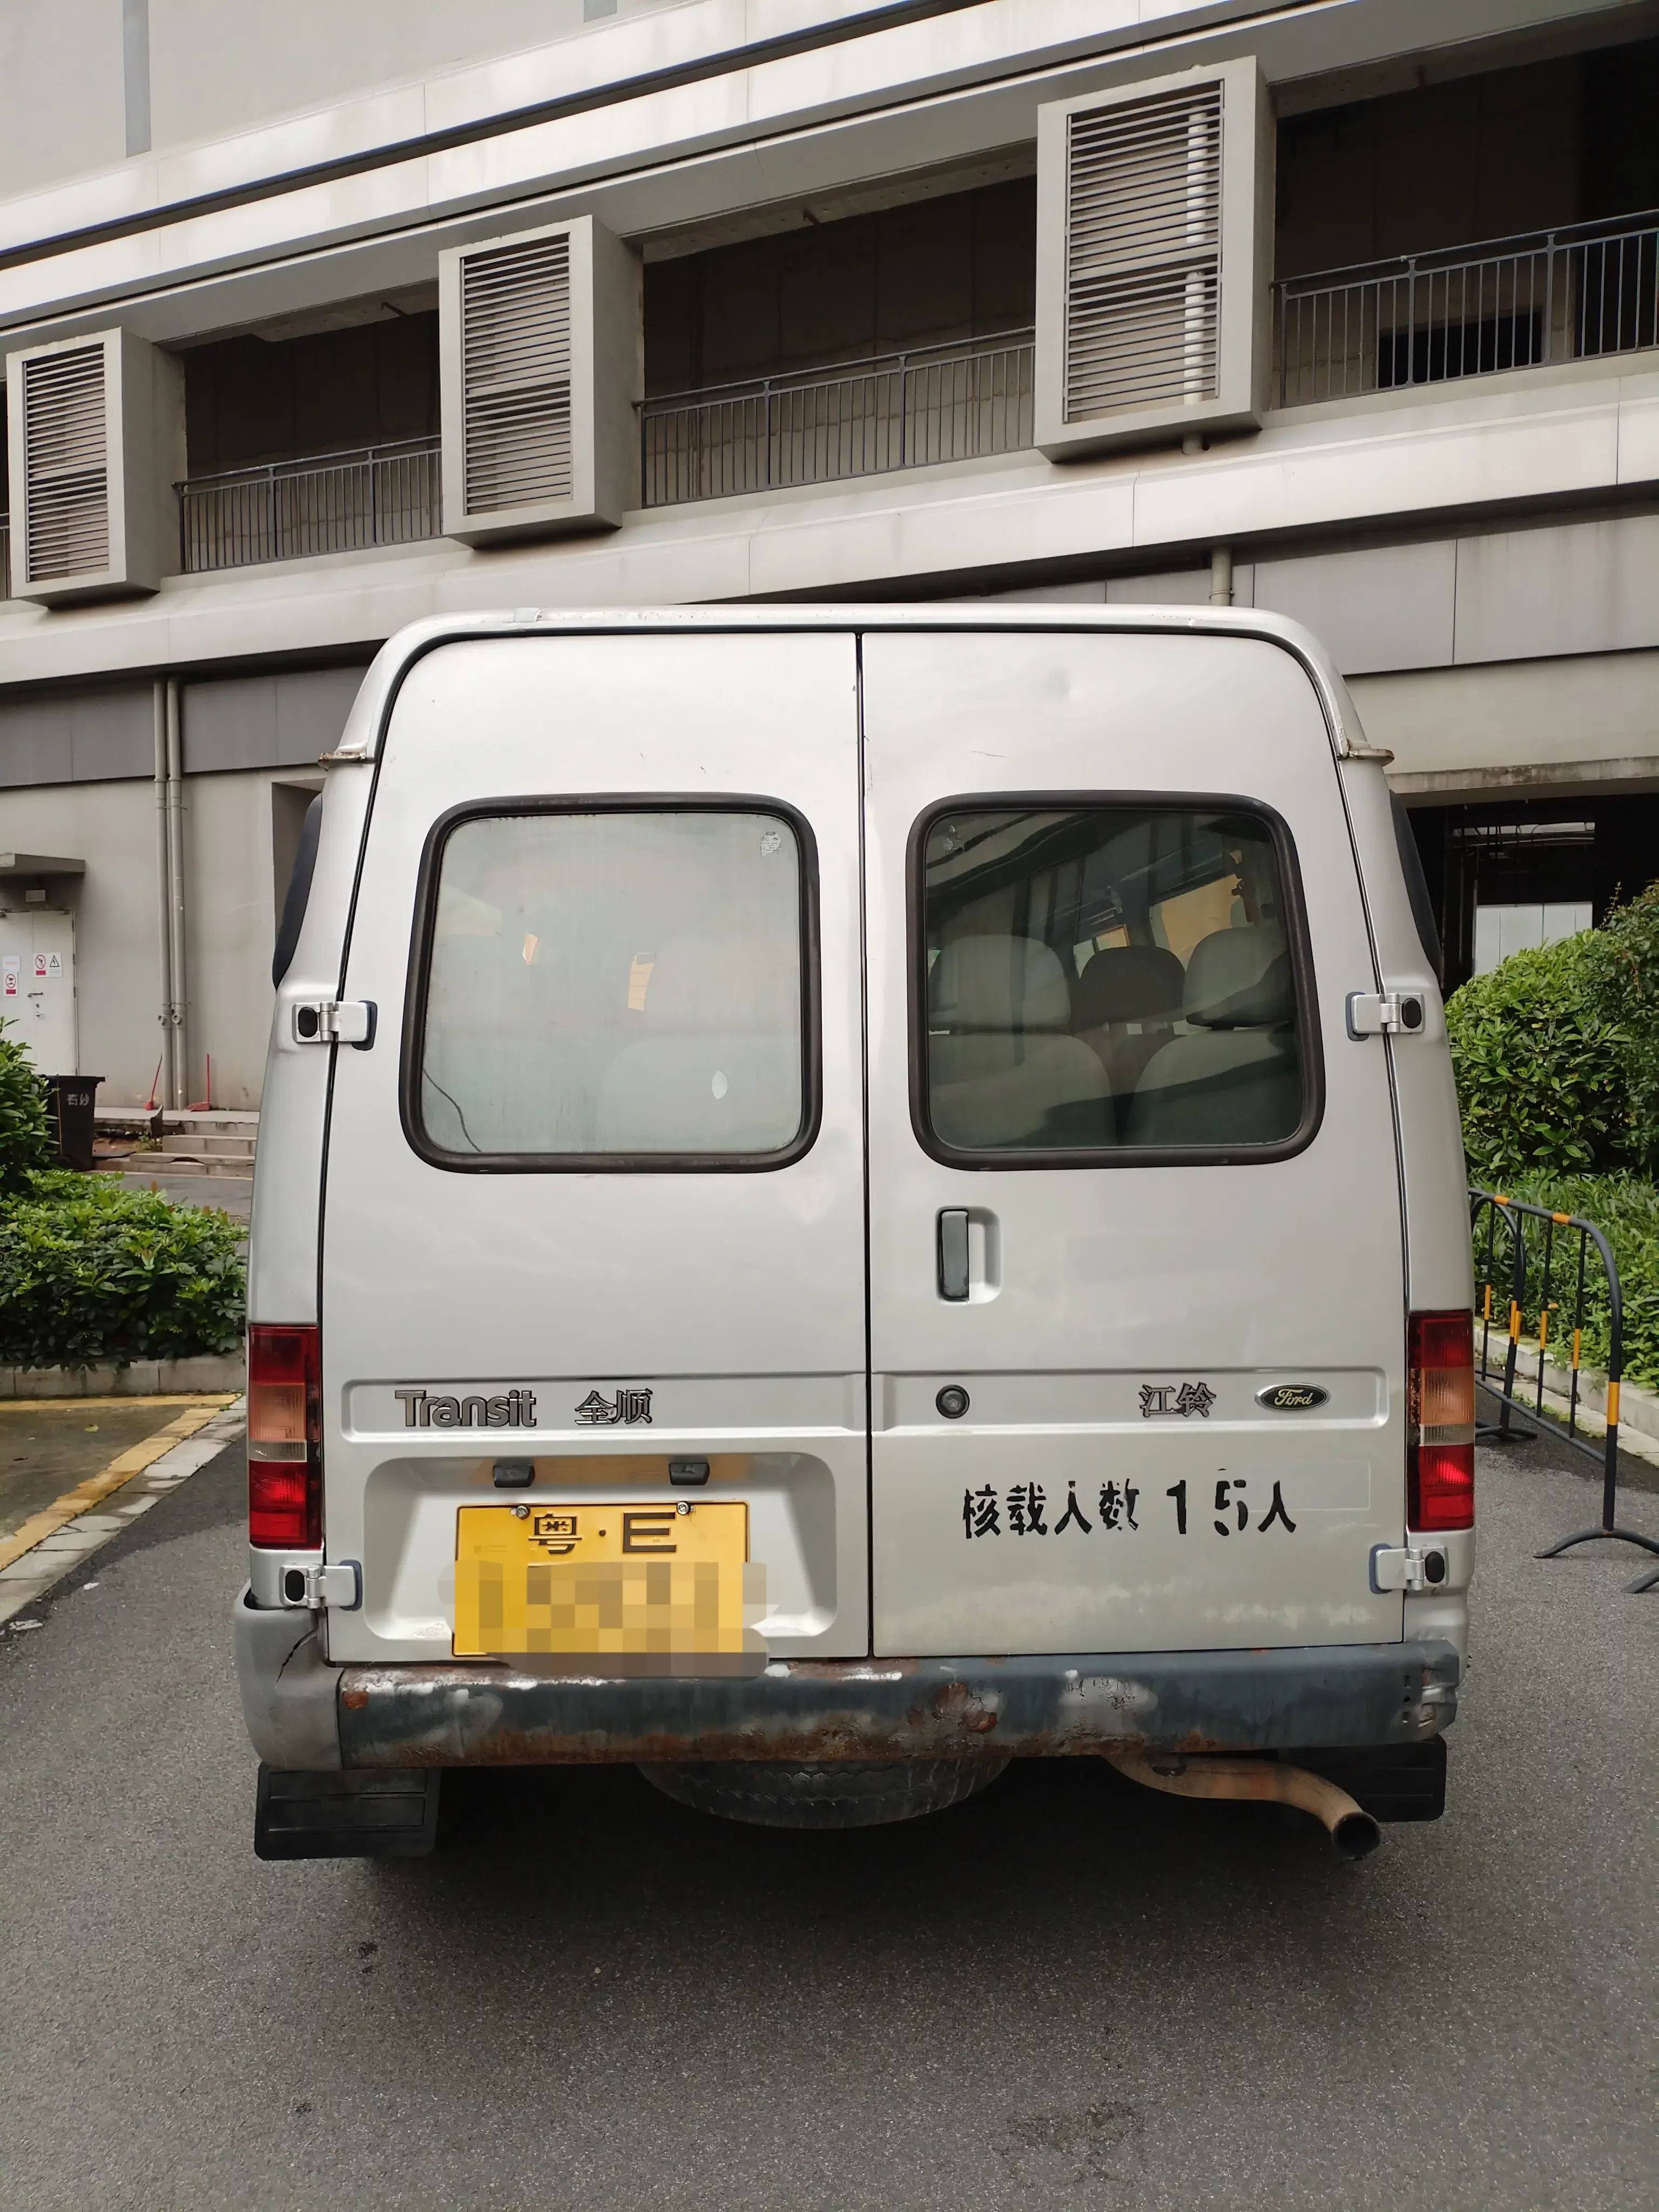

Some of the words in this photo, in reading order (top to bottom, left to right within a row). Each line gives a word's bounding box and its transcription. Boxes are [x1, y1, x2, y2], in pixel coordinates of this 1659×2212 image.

[395, 1389, 537, 1427] Transit
[575, 1387, 652, 1425] 全顺
[1138, 1381, 1217, 1418] 江铃
[1273, 1388, 1313, 1406] Ford
